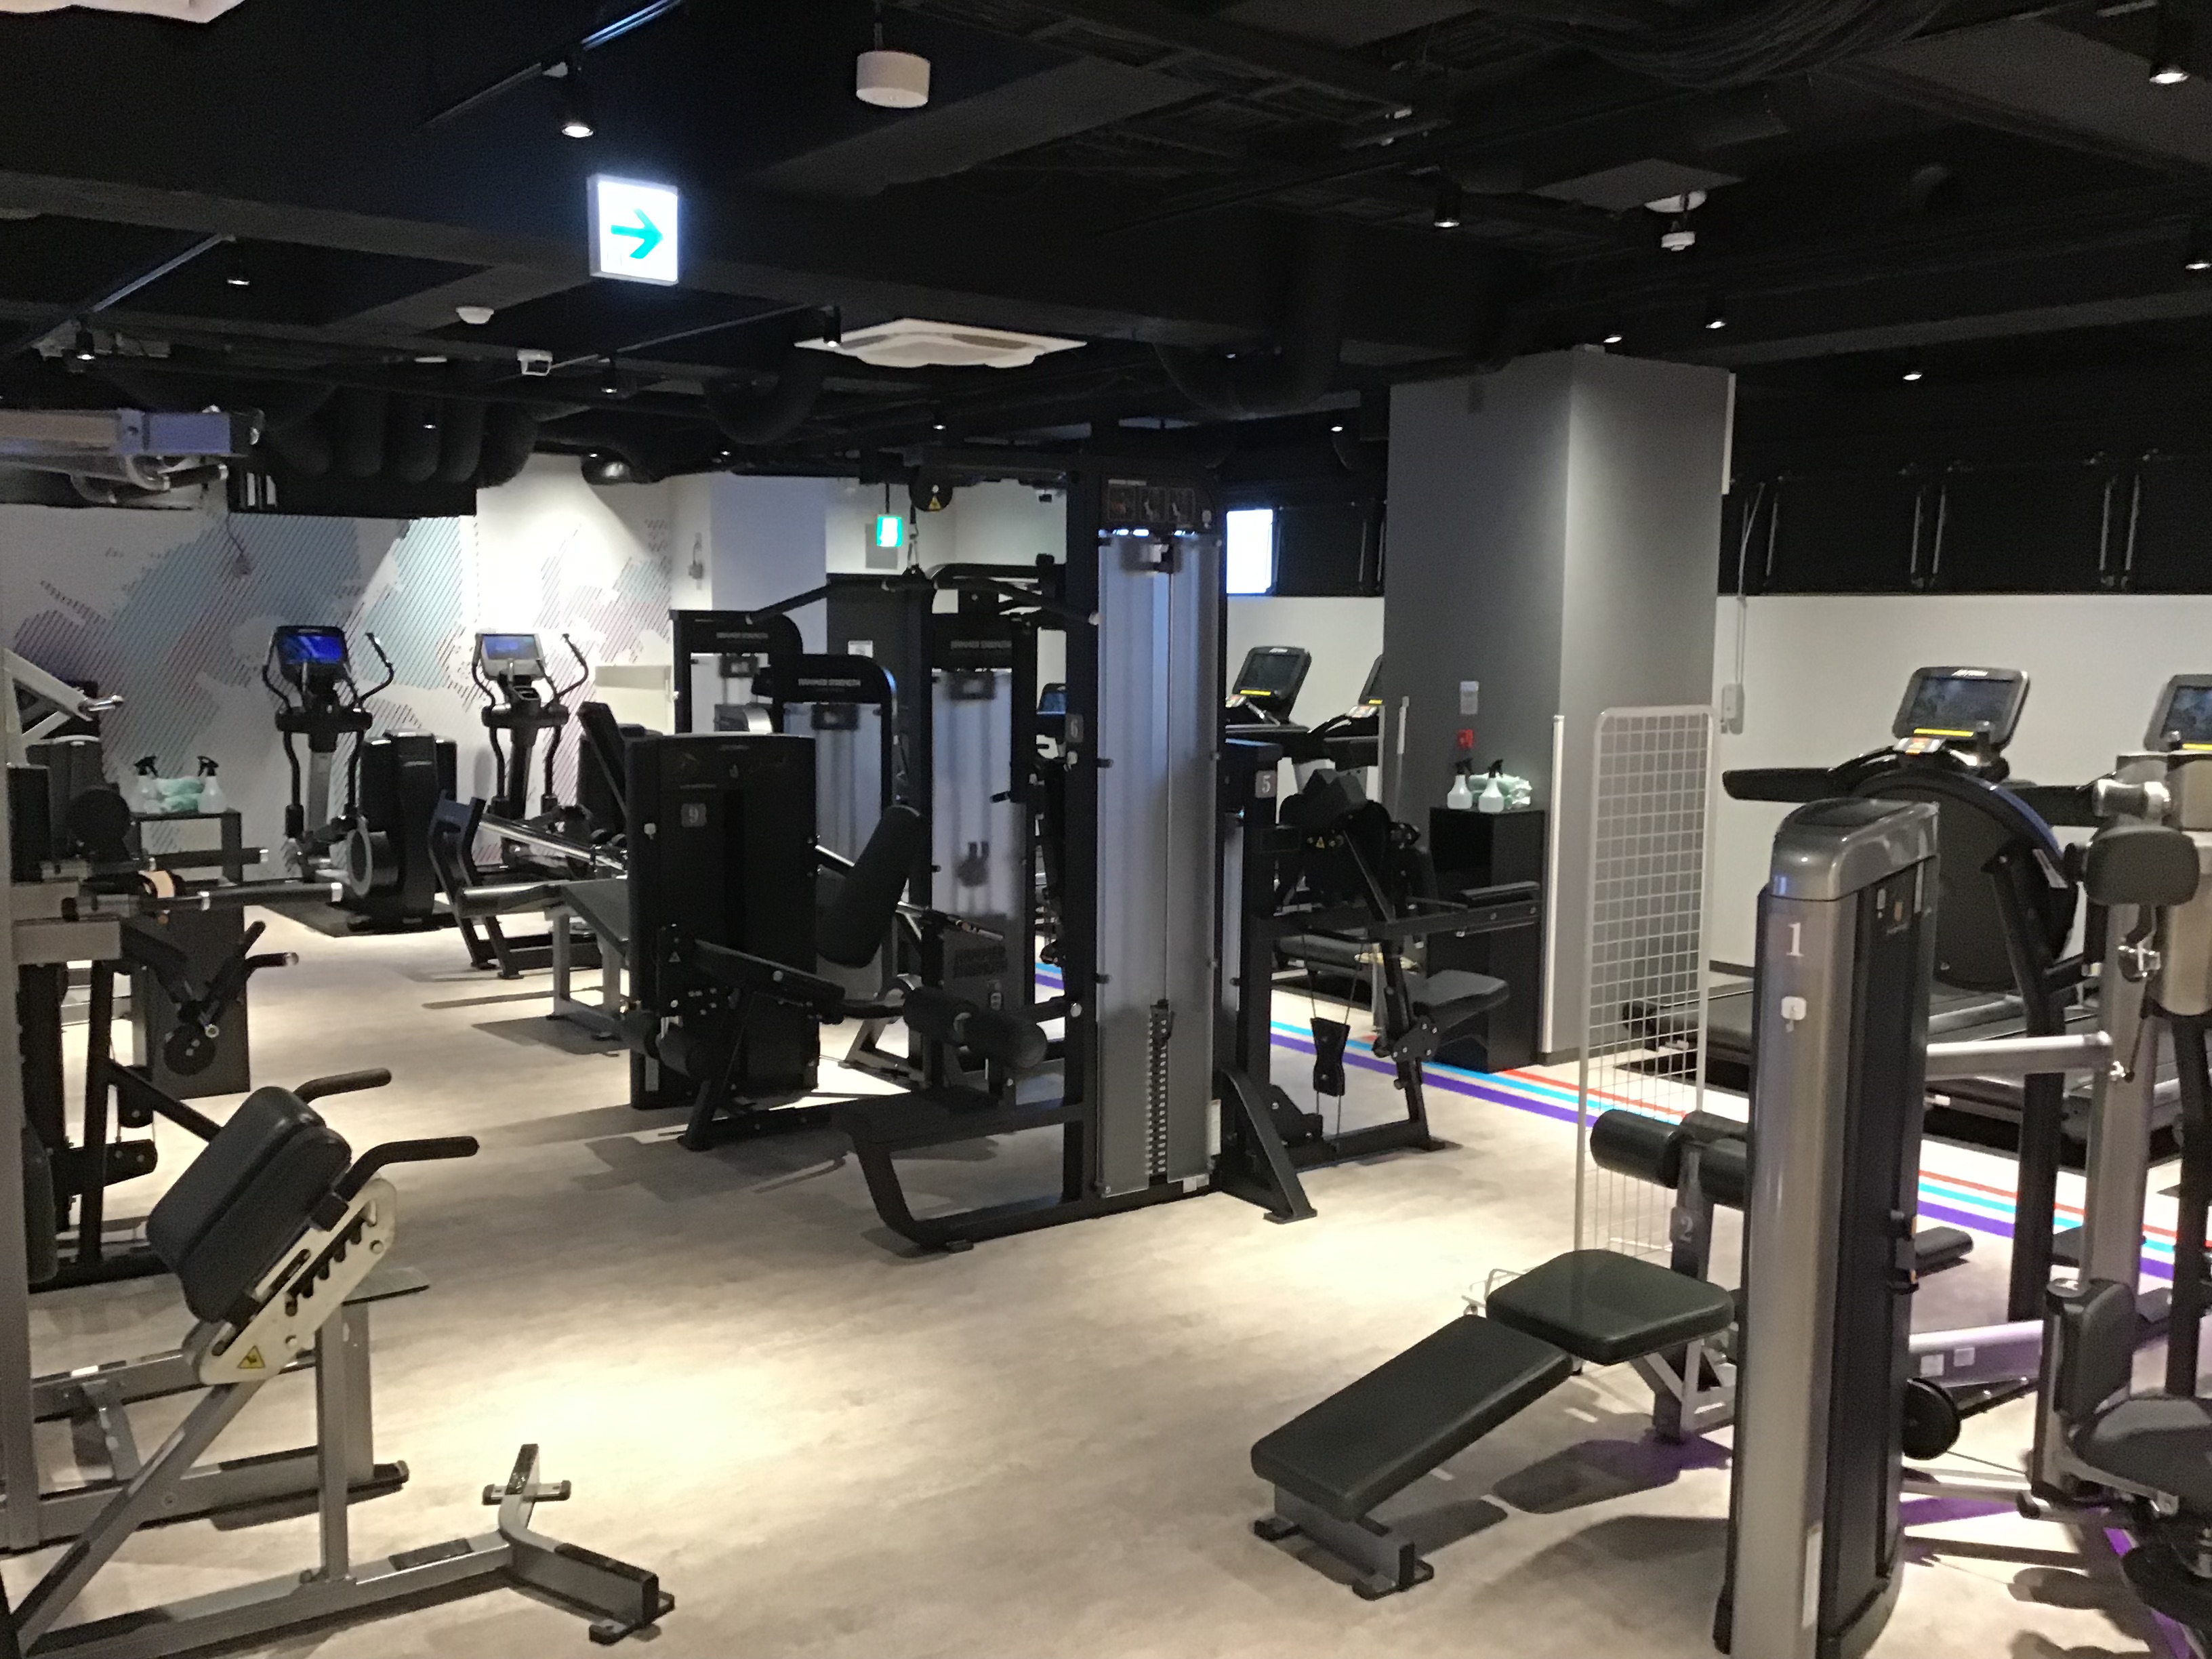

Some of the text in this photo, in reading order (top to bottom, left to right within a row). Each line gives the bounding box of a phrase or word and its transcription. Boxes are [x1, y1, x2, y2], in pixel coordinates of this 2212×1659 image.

[1071, 718, 1078, 739] 6
[1262, 775, 1271, 793] 5
[689, 806, 699, 823] 9
[1786, 922, 1805, 957] 1
[1680, 1216, 1694, 1242] 2
